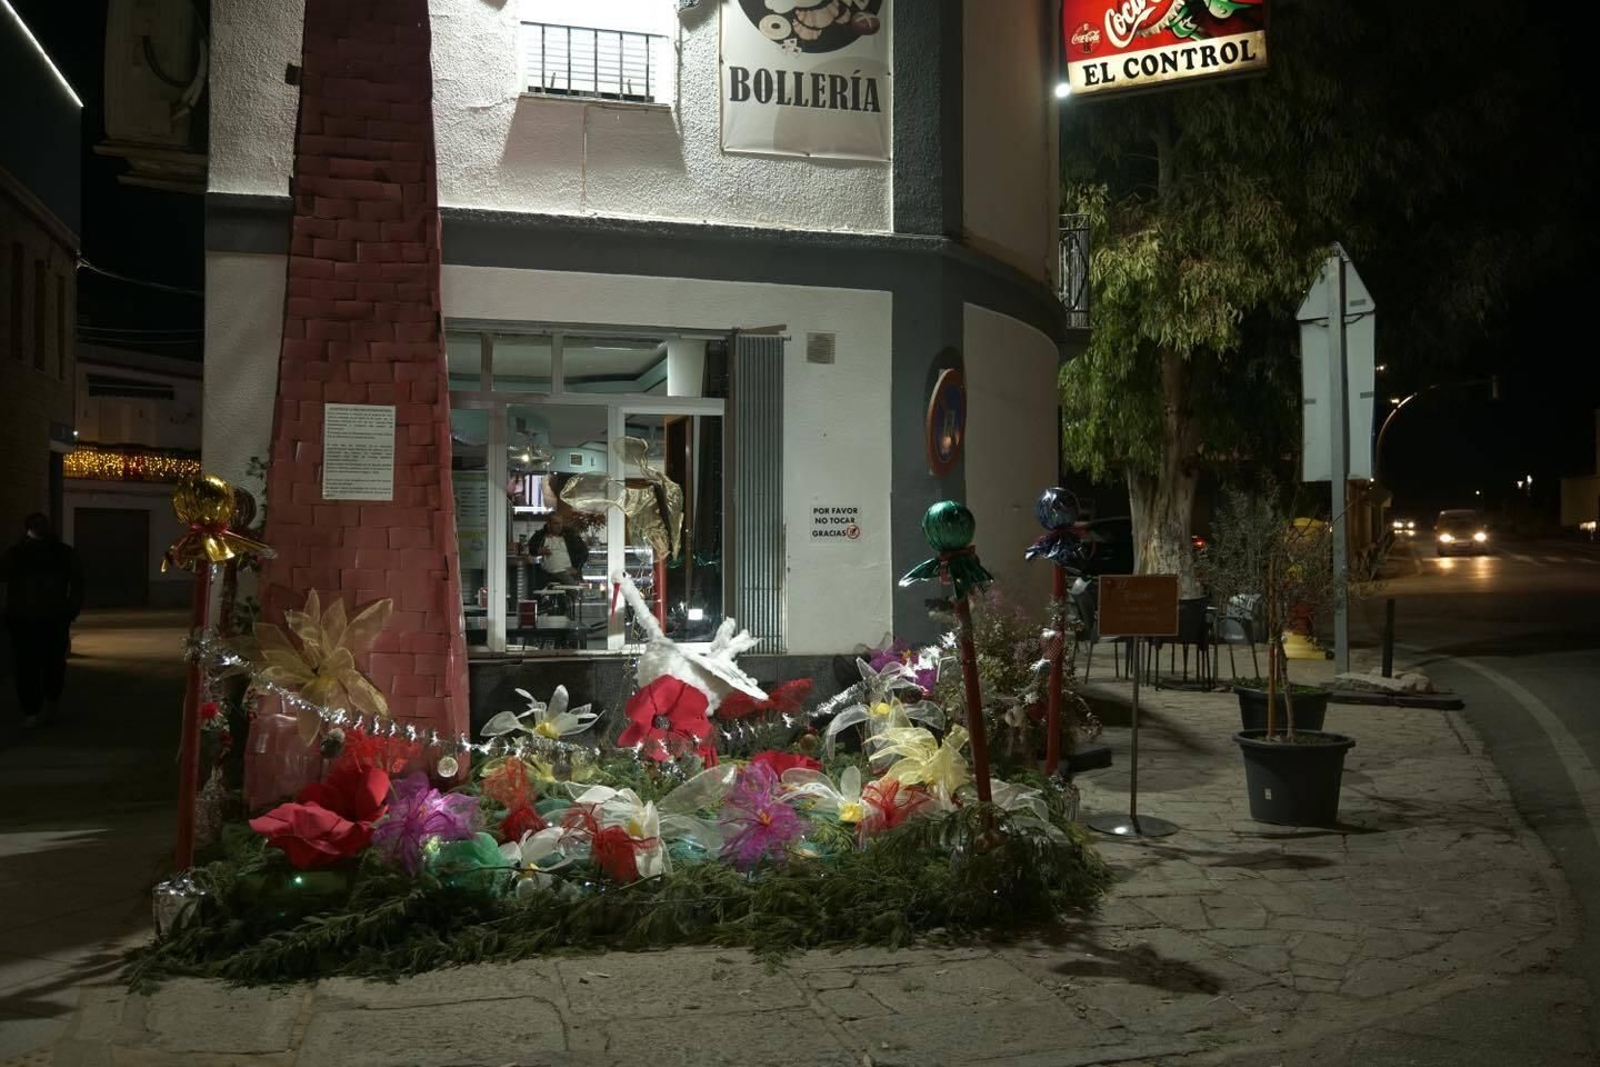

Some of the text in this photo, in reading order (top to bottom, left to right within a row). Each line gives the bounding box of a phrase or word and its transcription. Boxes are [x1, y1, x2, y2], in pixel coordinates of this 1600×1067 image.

[1083, 40, 1256, 86] EL CONTROL
[729, 66, 881, 112] BOLLERÍA
